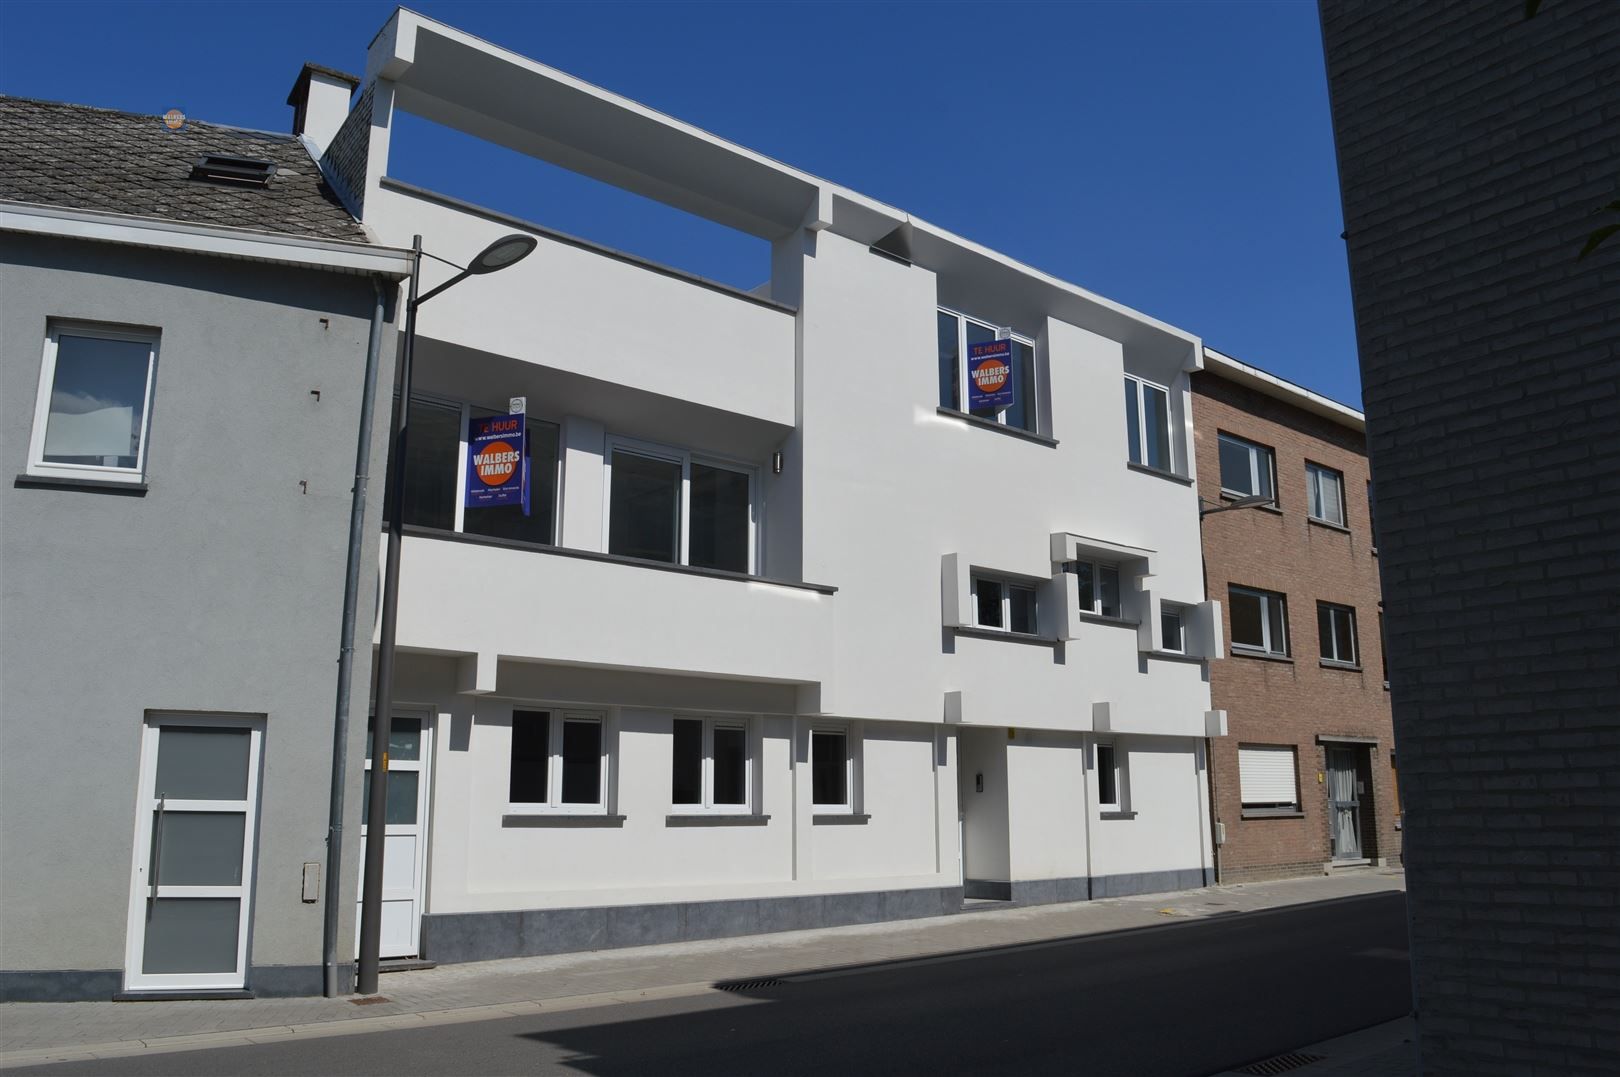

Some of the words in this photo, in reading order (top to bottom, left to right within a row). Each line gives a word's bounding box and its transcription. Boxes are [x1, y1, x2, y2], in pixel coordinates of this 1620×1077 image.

[971, 365, 1010, 379] WALBERS
[978, 375, 1004, 386] IMMO
[492, 420, 518, 432] HUUR
[473, 451, 520, 466] WALBERS
[480, 463, 512, 476] IMMO
